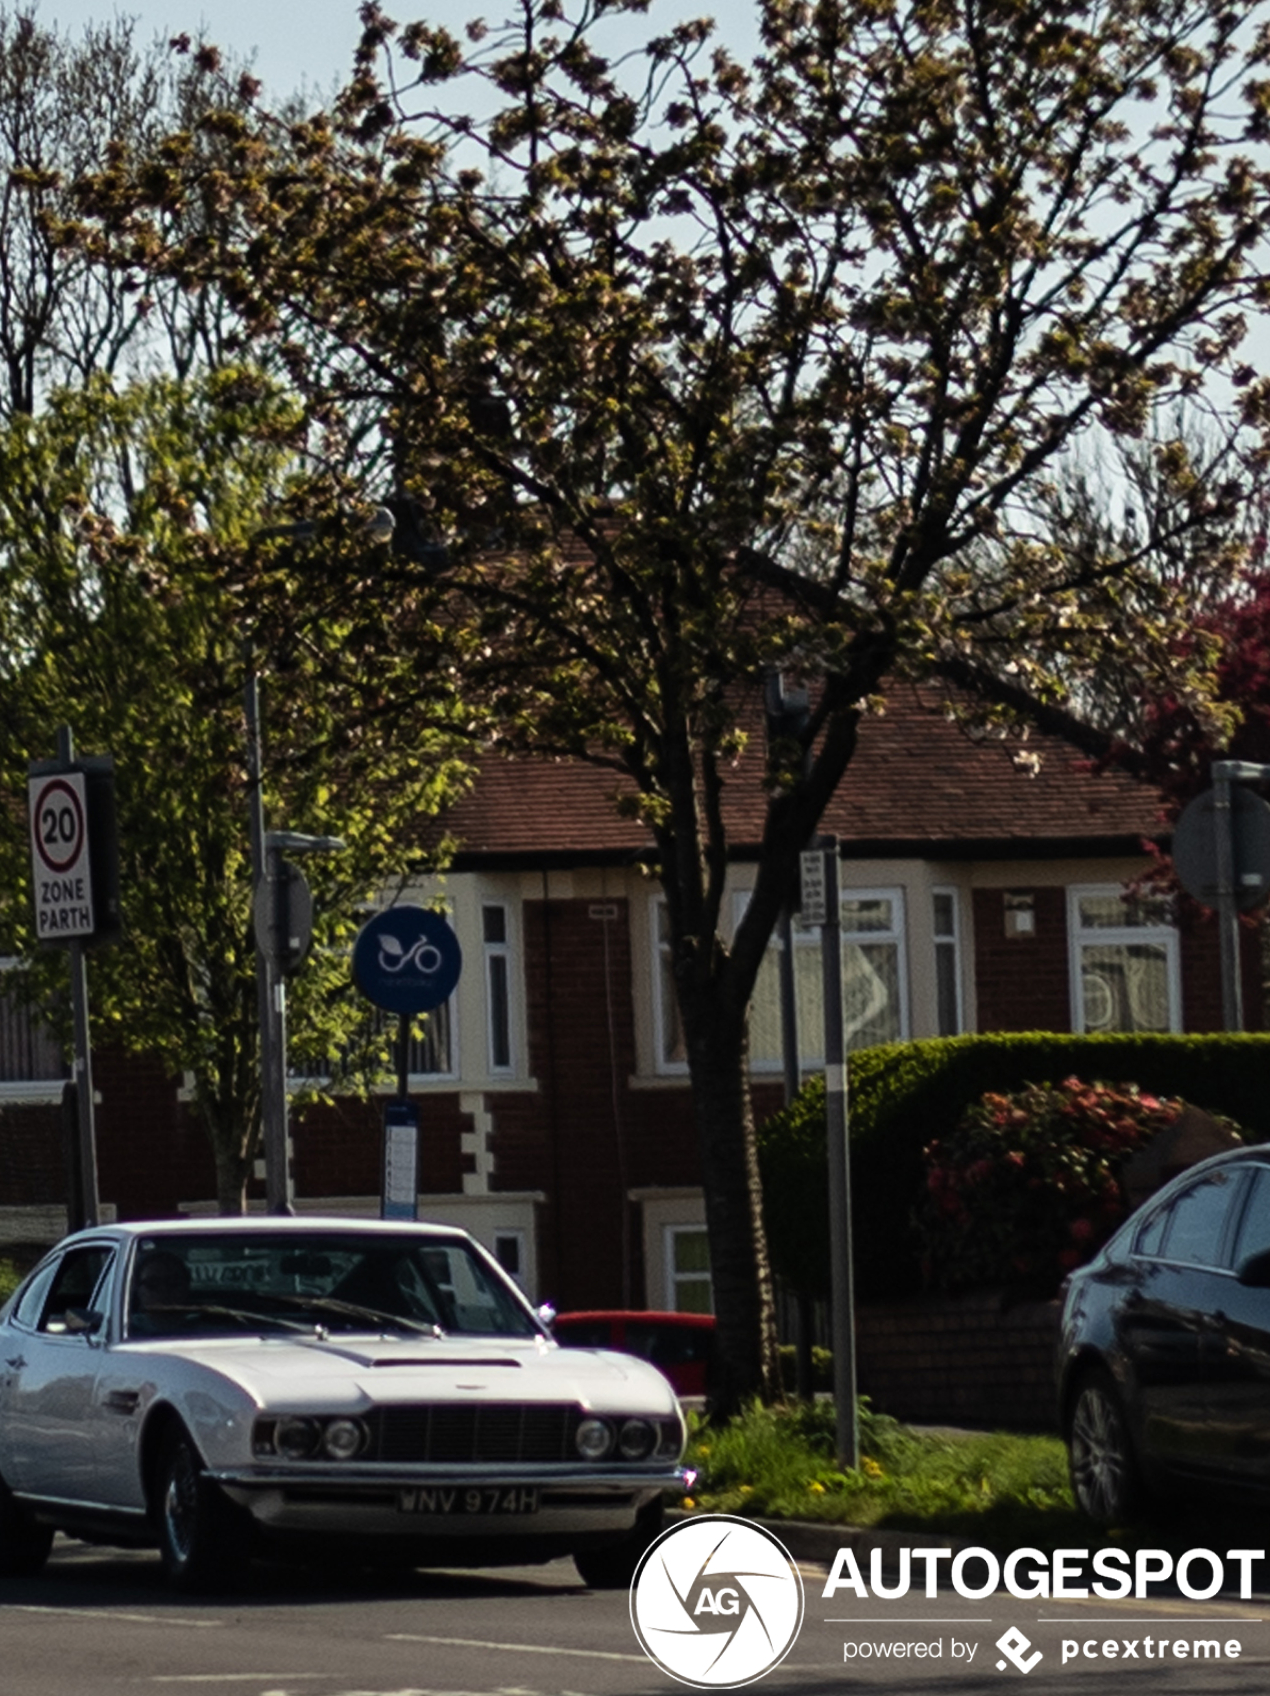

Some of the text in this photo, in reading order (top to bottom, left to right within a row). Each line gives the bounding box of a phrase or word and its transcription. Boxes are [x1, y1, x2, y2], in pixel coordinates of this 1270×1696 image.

[42, 807, 76, 844] 20
[41, 879, 85, 904] ZONE
[40, 906, 91, 932] PARTH
[401, 1488, 537, 1513] WNV 974H
